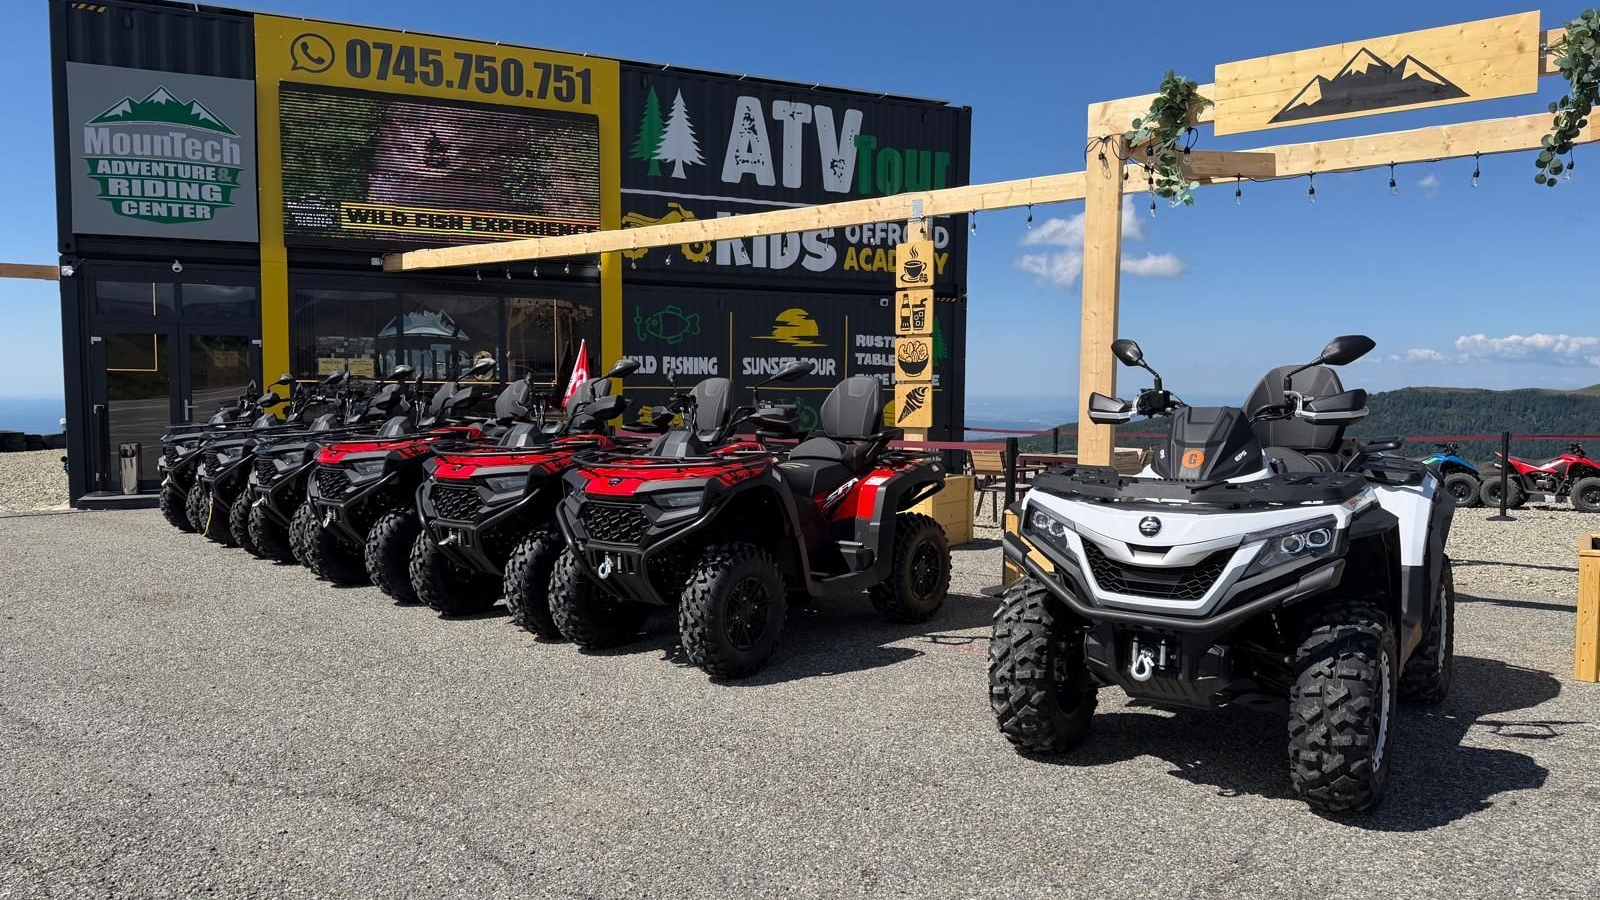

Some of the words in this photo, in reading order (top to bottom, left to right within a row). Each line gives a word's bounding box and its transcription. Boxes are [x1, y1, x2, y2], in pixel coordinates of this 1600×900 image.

[345, 39, 592, 105] 0745.750.751
[84, 127, 241, 165] MounTech
[721, 96, 863, 194] ATV
[854, 134, 950, 195] Tour
[108, 178, 222, 202] RIDING
[121, 201, 211, 218] CENTER
[347, 208, 408, 226] WILD
[415, 213, 463, 230] FISH
[716, 211, 837, 272] KIDS
[845, 222, 949, 249] OFFRD
[843, 246, 949, 275] ACADY
[663, 356, 718, 375] FISHING
[742, 356, 798, 375] SUNSE
[801, 357, 836, 376] OUR
